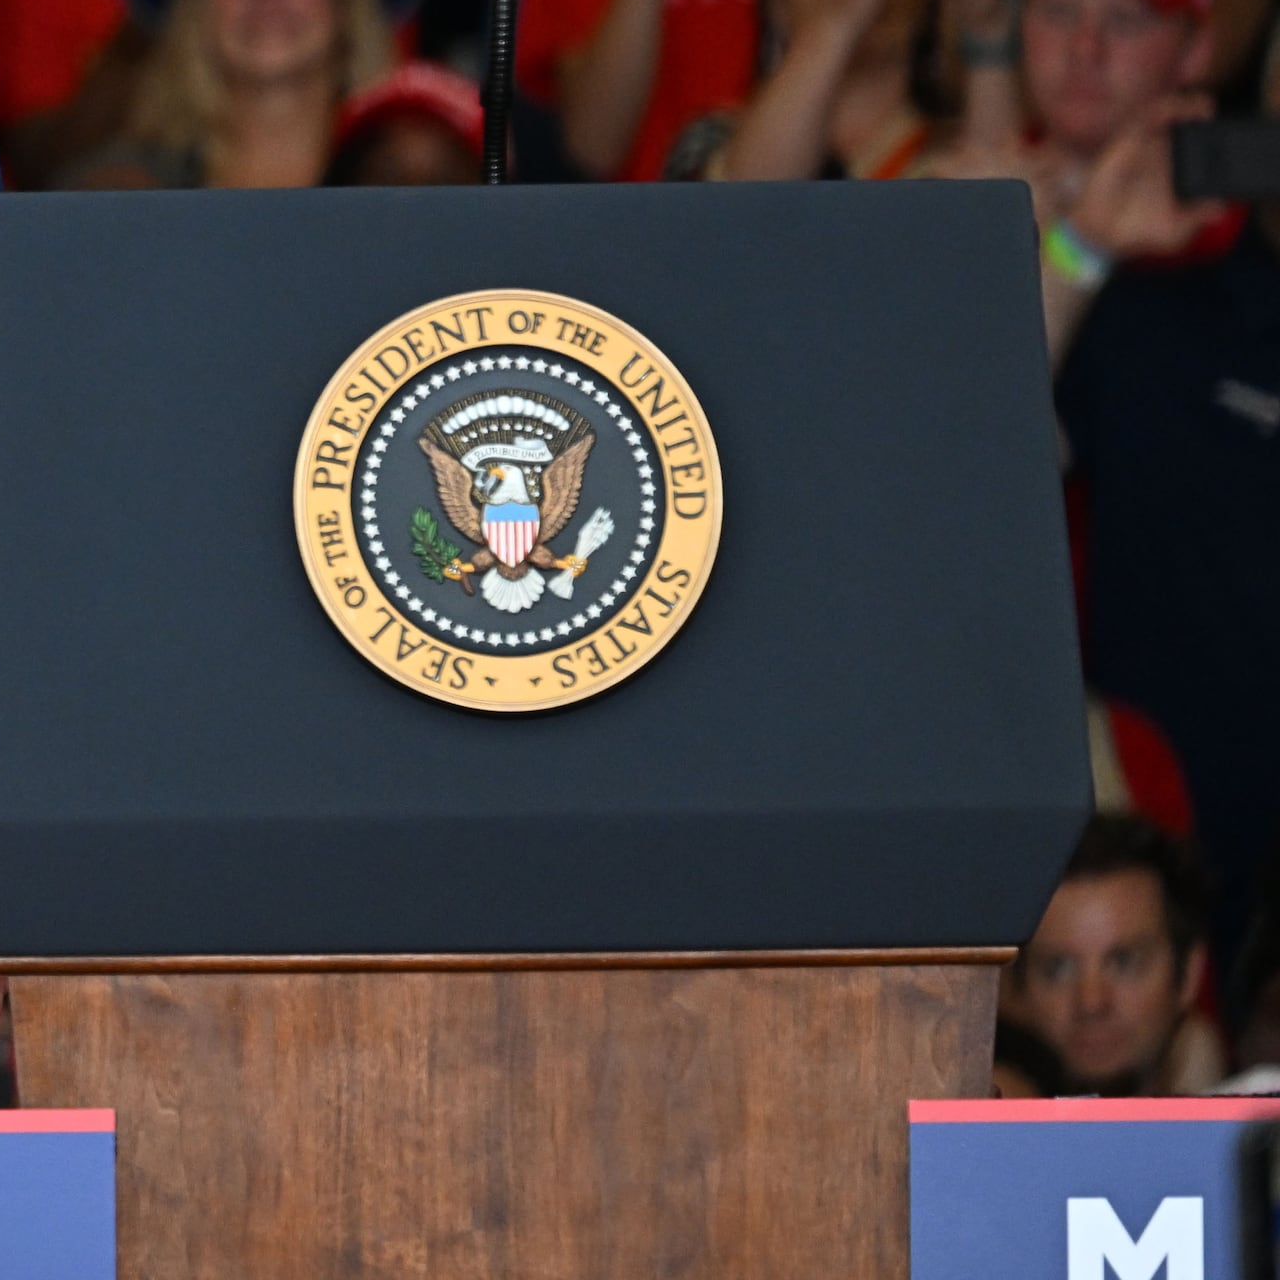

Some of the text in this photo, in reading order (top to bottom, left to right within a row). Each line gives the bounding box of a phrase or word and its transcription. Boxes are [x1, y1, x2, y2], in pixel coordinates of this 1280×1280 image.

[313, 306, 708, 691] SEAL OF THE PRESIDENT OF THE UNITED STATES
